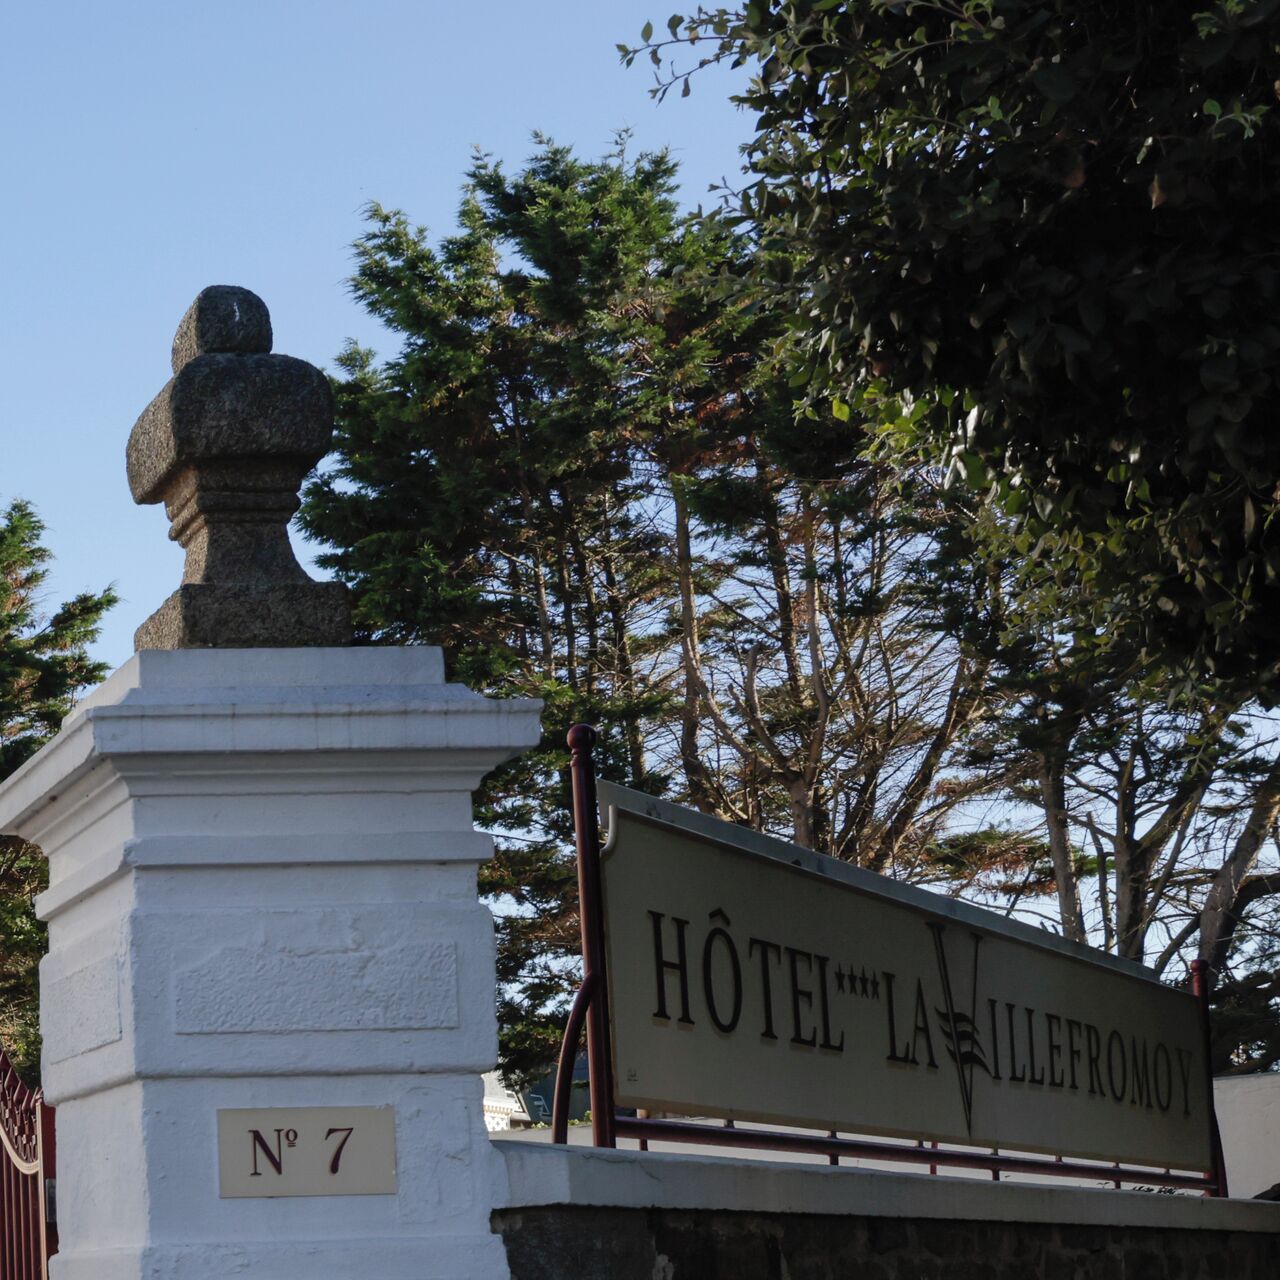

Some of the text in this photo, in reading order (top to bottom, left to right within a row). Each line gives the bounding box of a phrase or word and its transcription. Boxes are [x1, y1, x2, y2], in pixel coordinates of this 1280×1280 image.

[647, 907, 844, 1053] HÔTEL
[881, 970, 939, 1069] LA
[324, 1127, 354, 1175] 7
